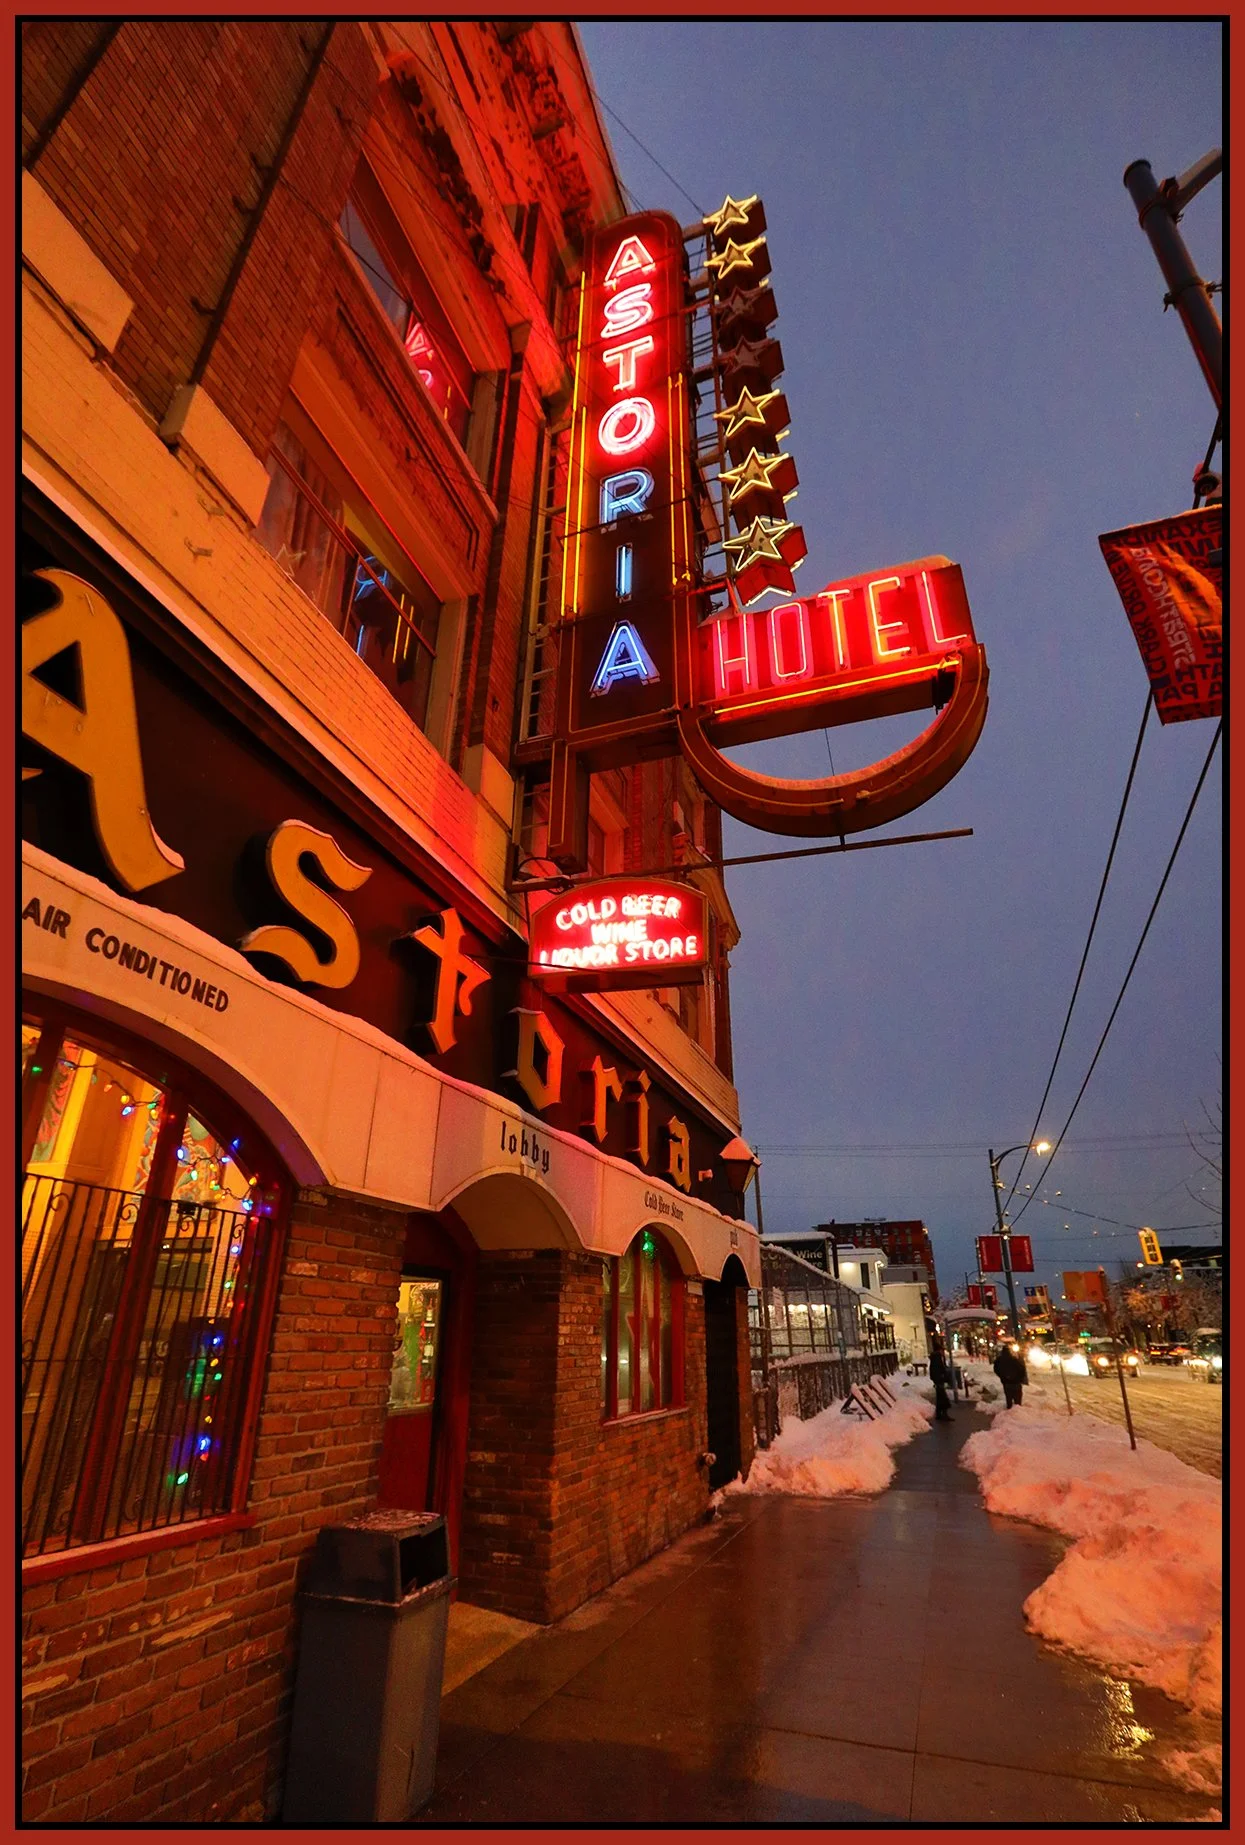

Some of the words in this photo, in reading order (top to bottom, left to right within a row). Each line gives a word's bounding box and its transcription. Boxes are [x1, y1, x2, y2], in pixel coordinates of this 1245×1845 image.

[590, 235, 661, 697] ASTORIA
[712, 571, 971, 692] HOTEL
[555, 895, 617, 931] COLD
[621, 893, 683, 919] BEER
[591, 919, 648, 944] WINE
[624, 935, 699, 962] STORE
[22, 897, 72, 940] AIR
[85, 927, 230, 1013] CONDITIONED
[500, 1120, 550, 1175] lobby
[644, 1190, 658, 1211] Cold
[796, 1249, 823, 1260] Wine
